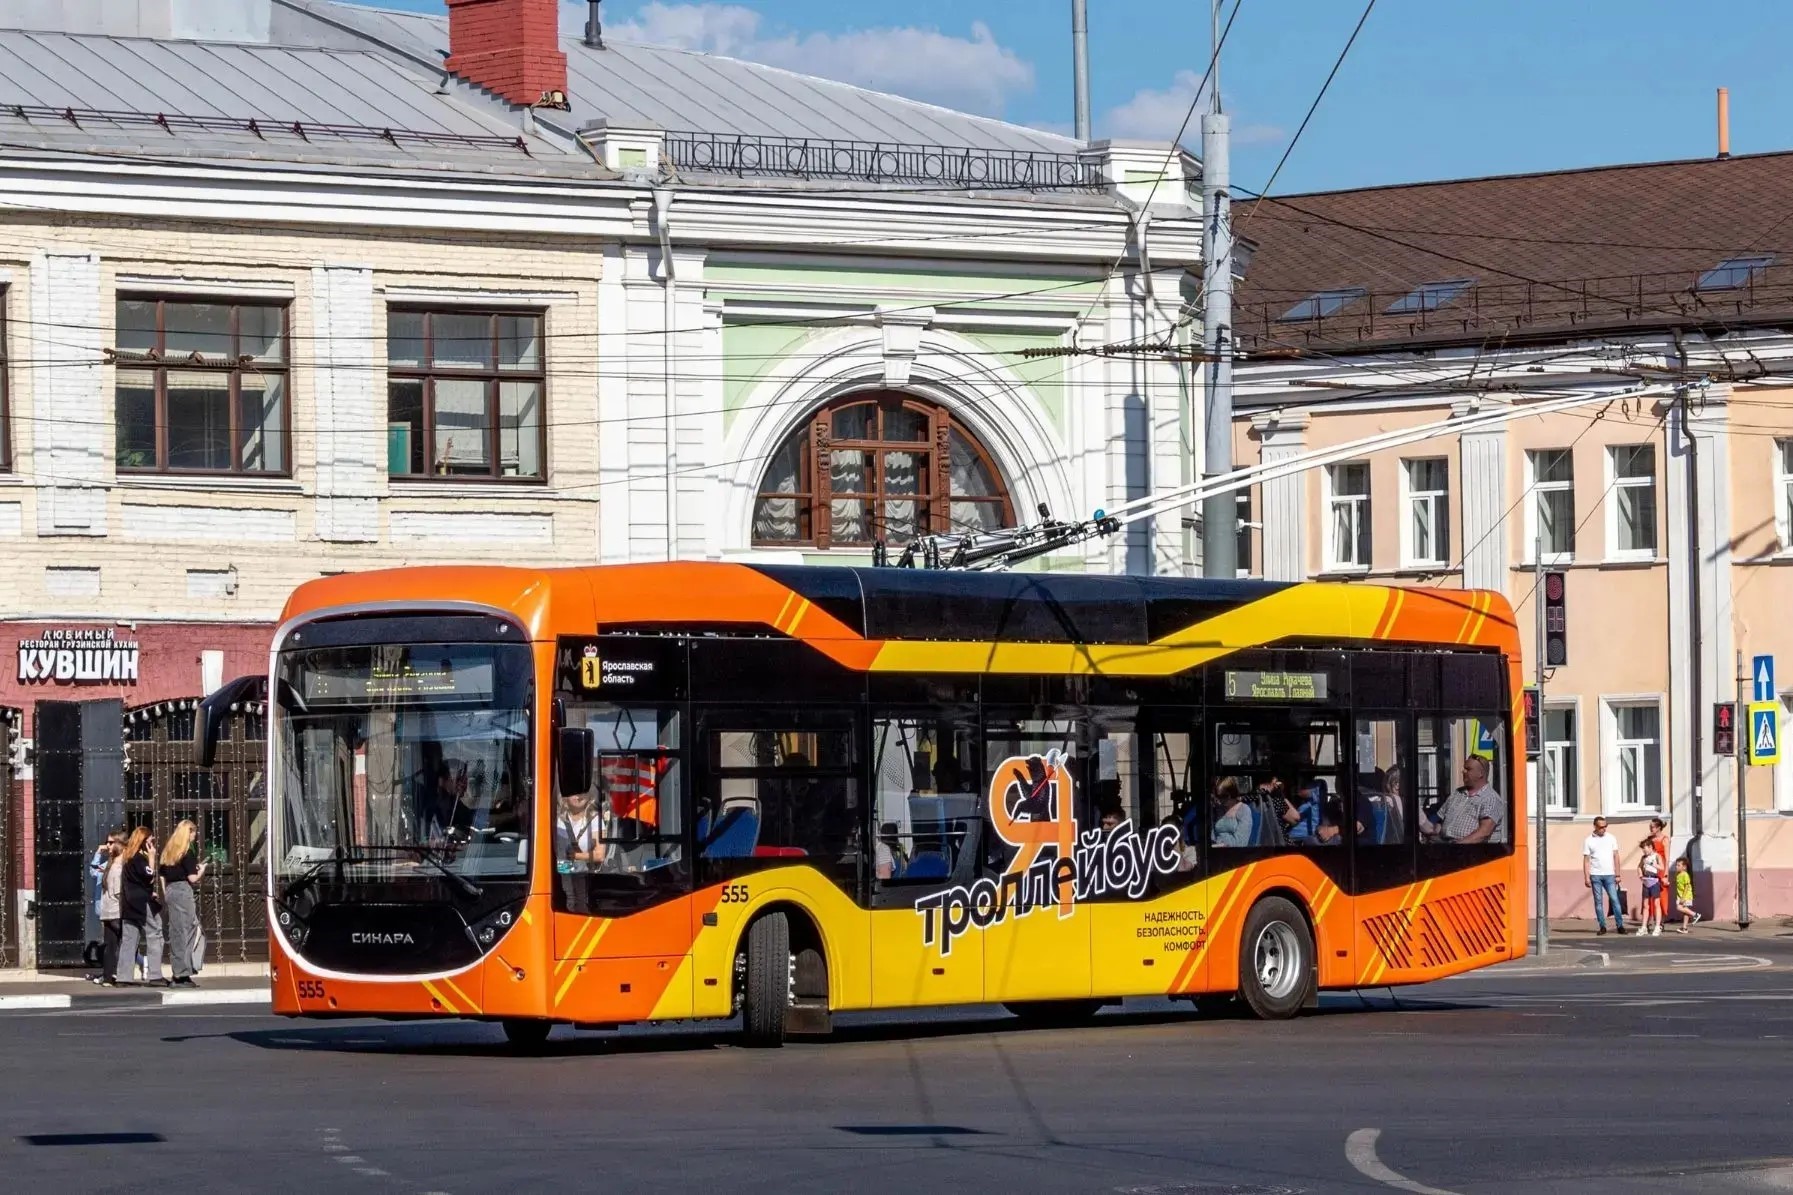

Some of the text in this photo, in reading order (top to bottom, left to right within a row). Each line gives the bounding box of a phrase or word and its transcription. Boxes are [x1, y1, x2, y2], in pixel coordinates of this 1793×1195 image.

[43, 628, 115, 640] ЛЮБИМЫЙ
[20, 640, 139, 649] РЕСТОРАН ГРУЗИНСКОЙ КУХНИ
[19, 649, 139, 679] КУВШИН
[602, 661, 653, 672] Ярославская
[602, 673, 635, 684] область
[1228, 672, 1236, 696] 5
[721, 885, 749, 903] 555
[915, 818, 1181, 958] троллейбус
[351, 932, 415, 944] СИНАРА
[1163, 940, 1207, 952] КОМФОРТ
[298, 980, 325, 998] 555
